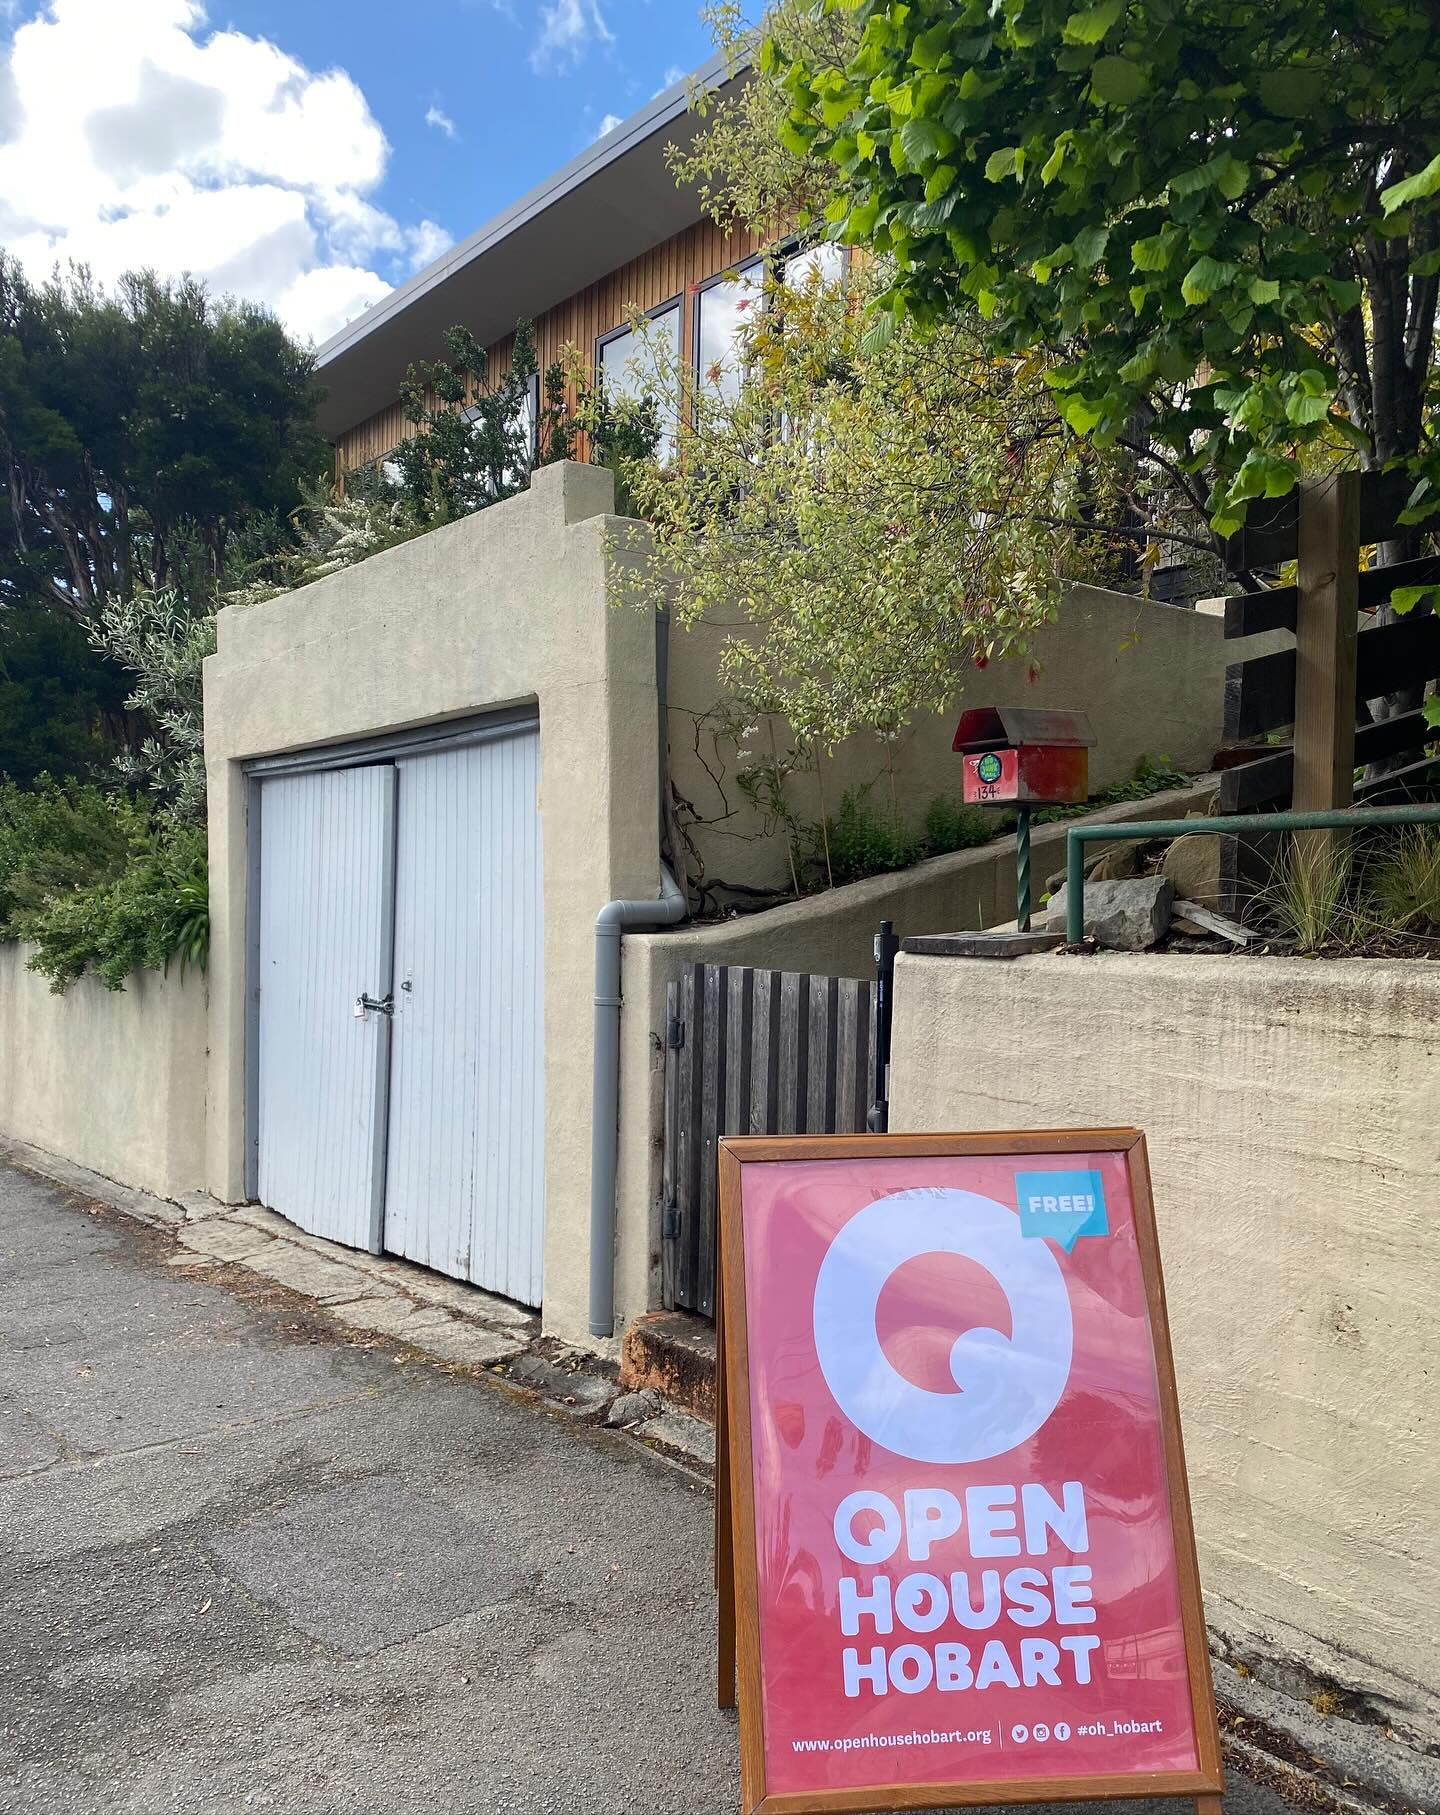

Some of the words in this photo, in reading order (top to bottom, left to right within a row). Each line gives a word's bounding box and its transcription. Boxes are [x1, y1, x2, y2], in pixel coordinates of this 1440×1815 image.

[977, 785, 997, 800] 134
[1028, 1195, 1094, 1213] FREE!
[833, 1481, 1089, 1564] OPEN
[838, 1565, 1096, 1636] HOUSE
[842, 1635, 1100, 1697] HOBART
[791, 1727, 992, 1753] www.openhousehobart.org
[1076, 1718, 1163, 1738] #oh_hobart
